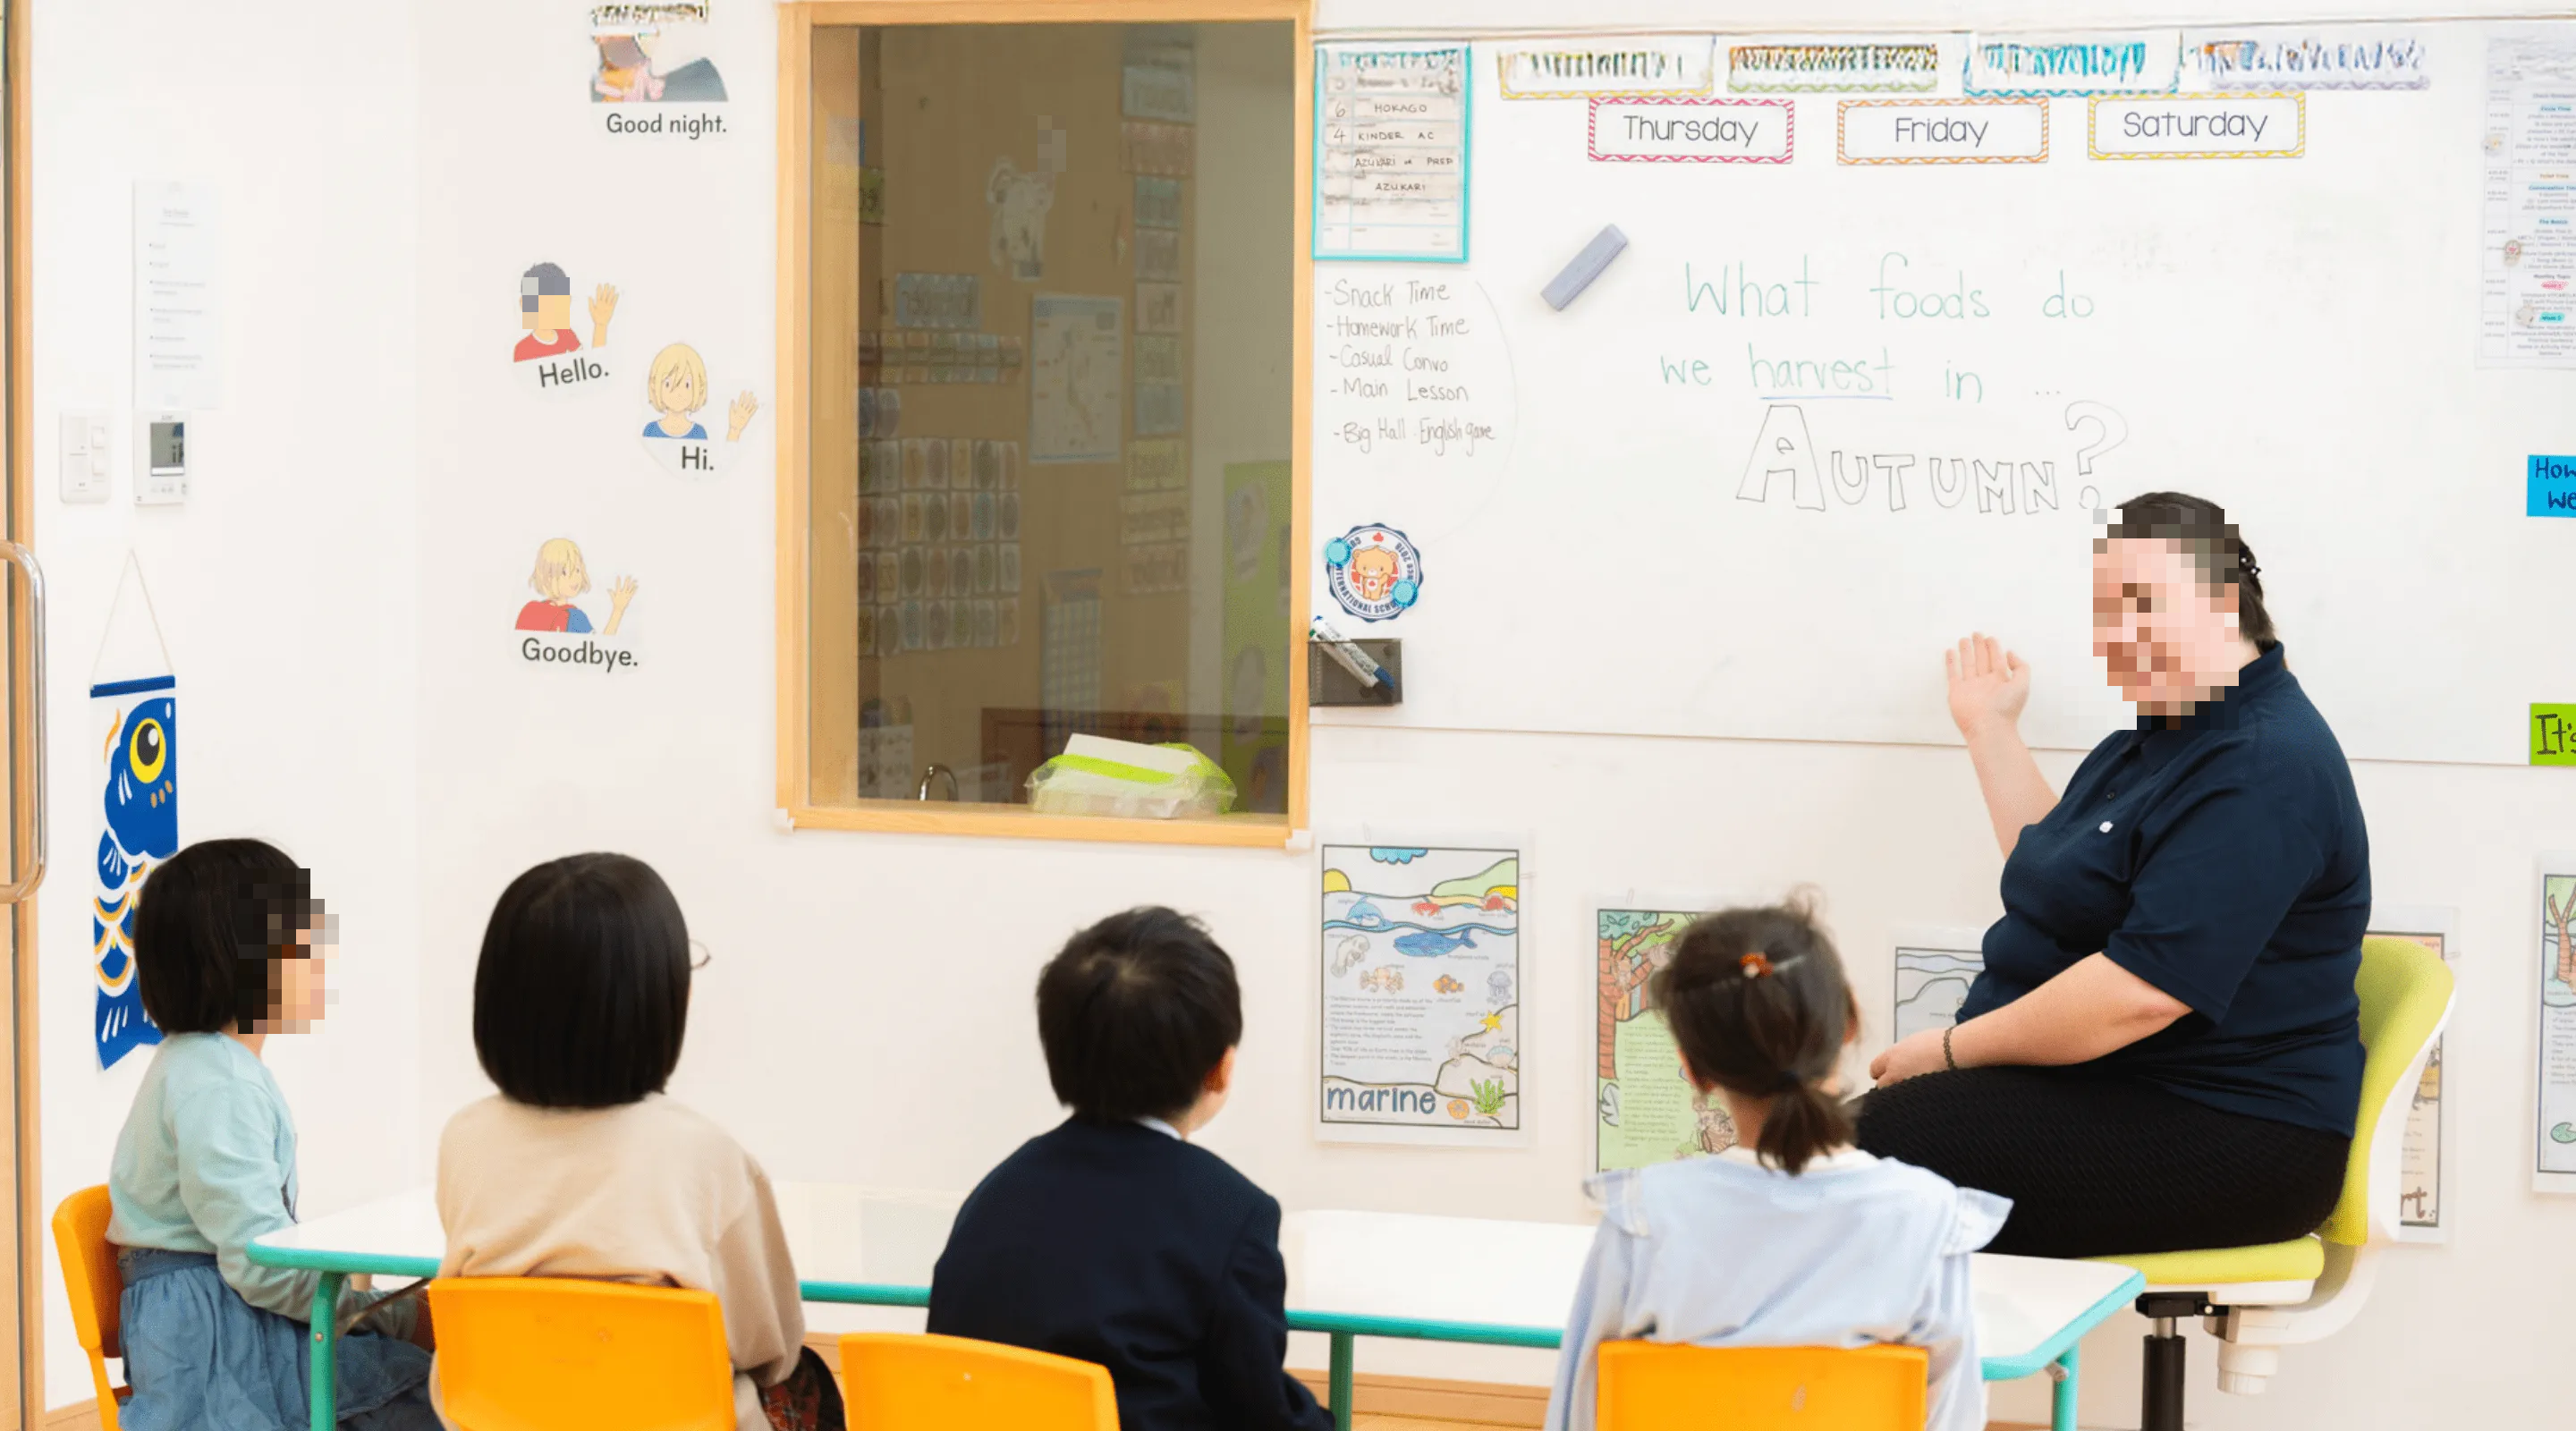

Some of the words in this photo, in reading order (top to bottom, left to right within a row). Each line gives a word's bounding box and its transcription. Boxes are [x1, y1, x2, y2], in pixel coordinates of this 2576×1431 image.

[1374, 103, 1428, 114] HOKAGO
[606, 113, 662, 133] Good
[670, 113, 727, 140] night.
[1358, 131, 1404, 141] KINDER
[1623, 114, 1758, 148] Thursday
[1895, 117, 1988, 148] Friday
[2123, 111, 2268, 141] Saturday
[1406, 280, 1451, 304] Time
[1686, 254, 1819, 317] What
[1869, 251, 1991, 319] foods
[2042, 268, 2094, 318] do
[1426, 315, 1470, 337] Time
[538, 357, 610, 387] Hello.
[1402, 347, 1449, 372] Convo
[1660, 354, 1712, 385] we
[1749, 342, 1895, 394] harvest
[1945, 360, 1983, 402] in
[1407, 377, 1470, 402] Lesson
[1377, 417, 1407, 441] Hall
[682, 445, 714, 471] Hi.
[521, 637, 638, 673] Goodbye.
[1327, 1087, 1436, 1114] marine
